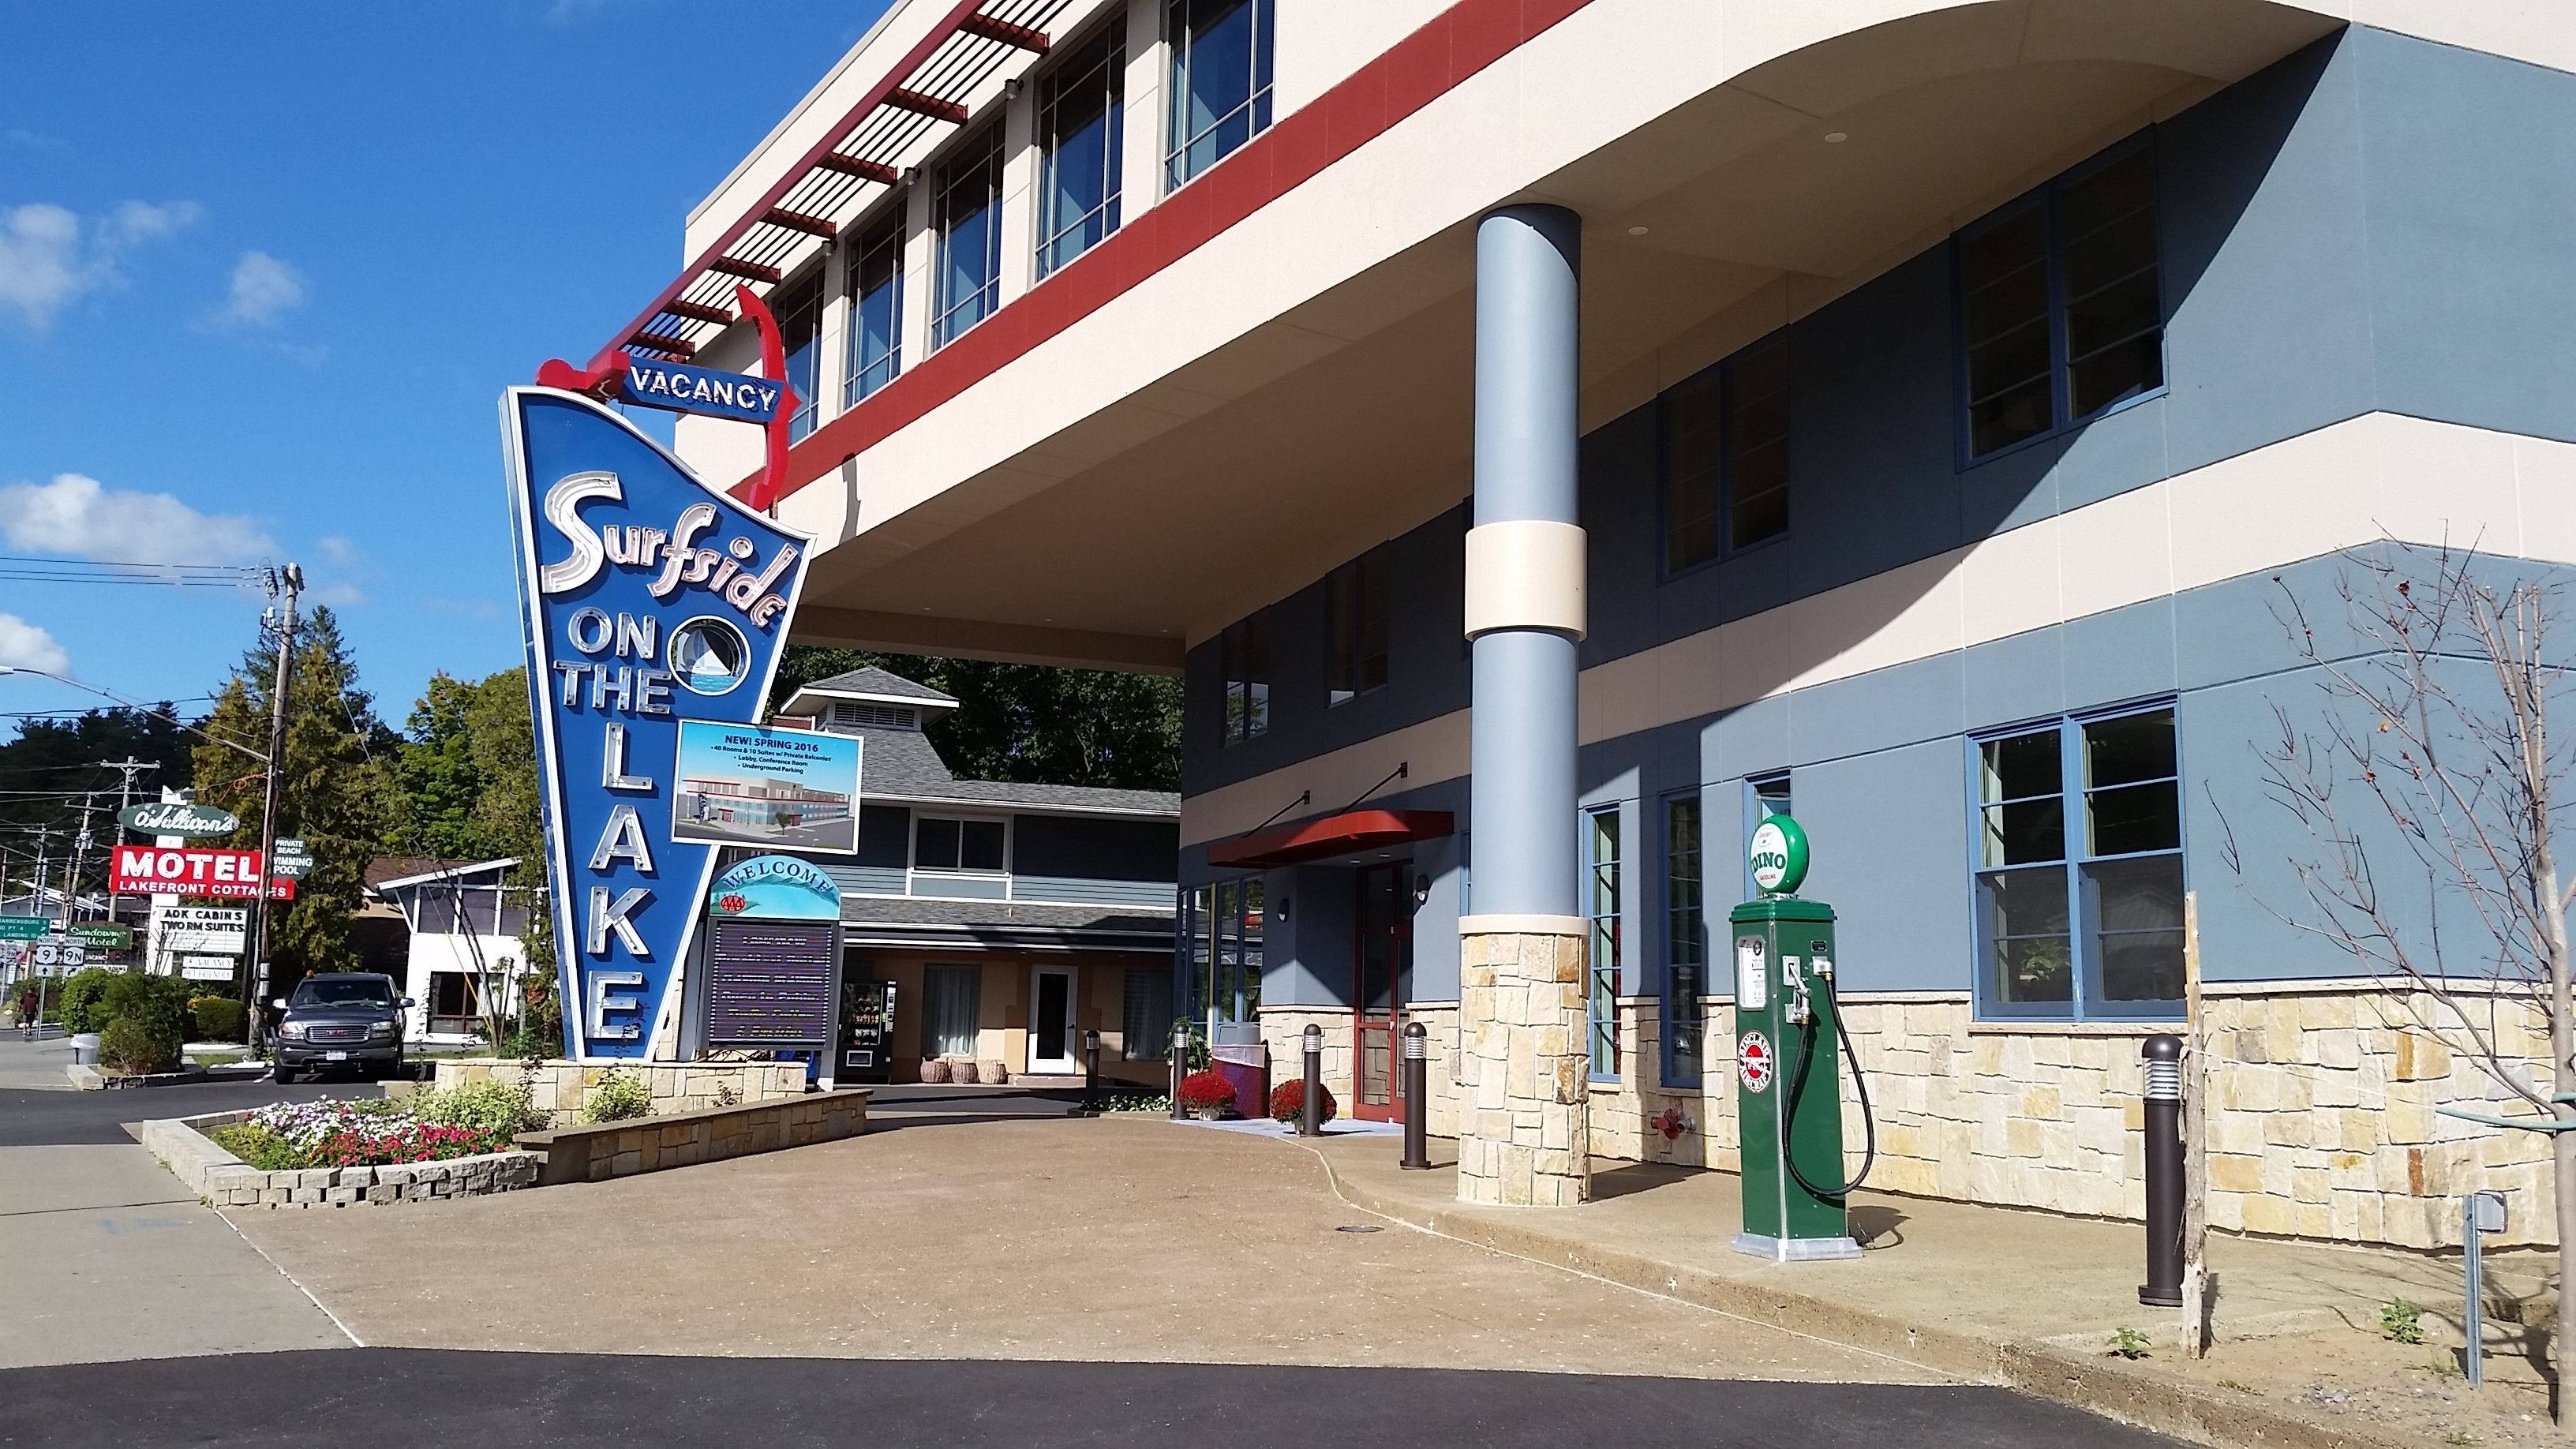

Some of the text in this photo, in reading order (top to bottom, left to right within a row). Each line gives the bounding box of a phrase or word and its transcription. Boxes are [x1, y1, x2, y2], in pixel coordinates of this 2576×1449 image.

[630, 365, 777, 412] VACANCY
[541, 470, 799, 628] Surfside
[568, 606, 656, 660] ON
[552, 659, 672, 715] THE
[724, 735, 818, 752] NEW! SPRING 2016
[742, 762, 803, 775] Underground Parking
[758, 756, 791, 766] Conference
[134, 806, 234, 833] O'Sullivan's
[275, 839, 304, 848] PRIVATE
[120, 851, 260, 882] MOTEL
[273, 856, 313, 867] WIMMING
[273, 865, 300, 875] POOL
[1751, 852, 1787, 874] DINO
[585, 721, 653, 1039] LAKE
[724, 861, 831, 896] WELCOME
[119, 880, 286, 897] LAKEFRONT COTTAES
[721, 896, 745, 912] AAA
[164, 908, 189, 919] ADK
[160, 920, 245, 932] TWO RM SUITES
[43, 949, 51, 960] 9
[66, 950, 82, 962] 9N
[1739, 1033, 1770, 1056] SINCLAIR
[1739, 1064, 1770, 1090] AIRCRAFT
